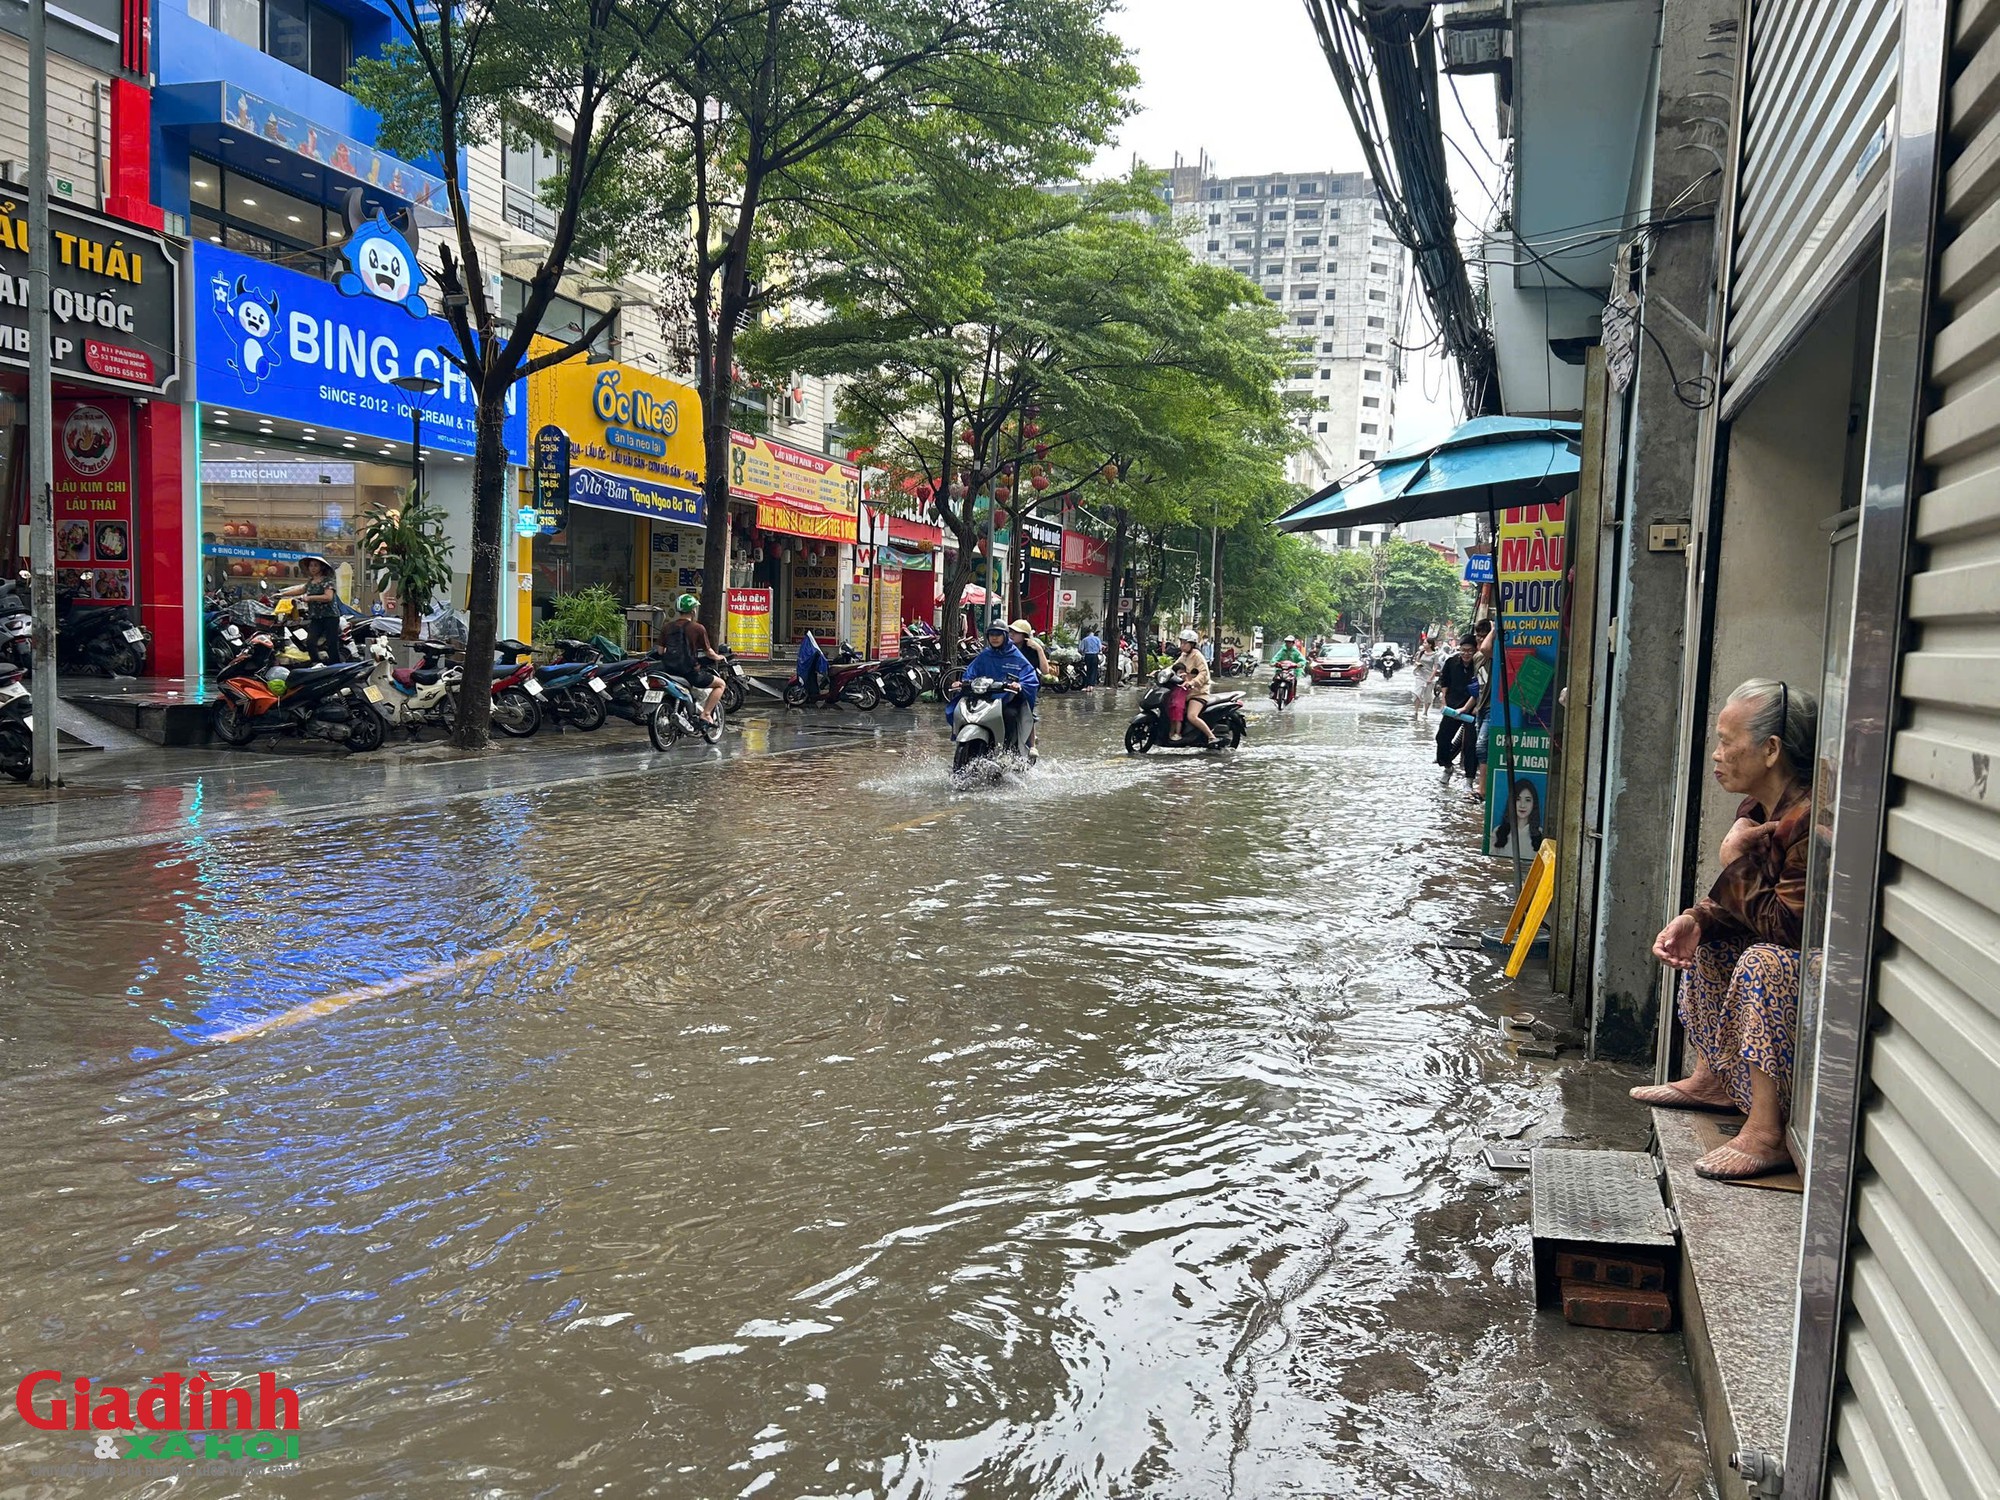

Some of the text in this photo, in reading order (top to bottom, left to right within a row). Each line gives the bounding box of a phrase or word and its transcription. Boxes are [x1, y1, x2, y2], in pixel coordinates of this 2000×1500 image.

[55, 230, 143, 285] THÁI
[53, 288, 134, 333] QUỐC
[289, 310, 517, 416] BING CHN
[359, 394, 388, 413] 2012
[419, 409, 454, 428] CREAM
[456, 416, 464, 429] &
[466, 418, 479, 433] TE
[80, 481, 103, 492] KIM
[106, 481, 126, 492] CHI
[604, 478, 628, 500] Bán
[629, 486, 651, 508] Tặng
[651, 491, 672, 511] Ngao
[1500, 530, 1565, 573] MÀU
[1512, 631, 1552, 645] LẤY NGAY
[1496, 734, 1519, 747] CHP
[1521, 731, 1539, 749] ẢNH
[1499, 754, 1549, 769] LY NGAY
